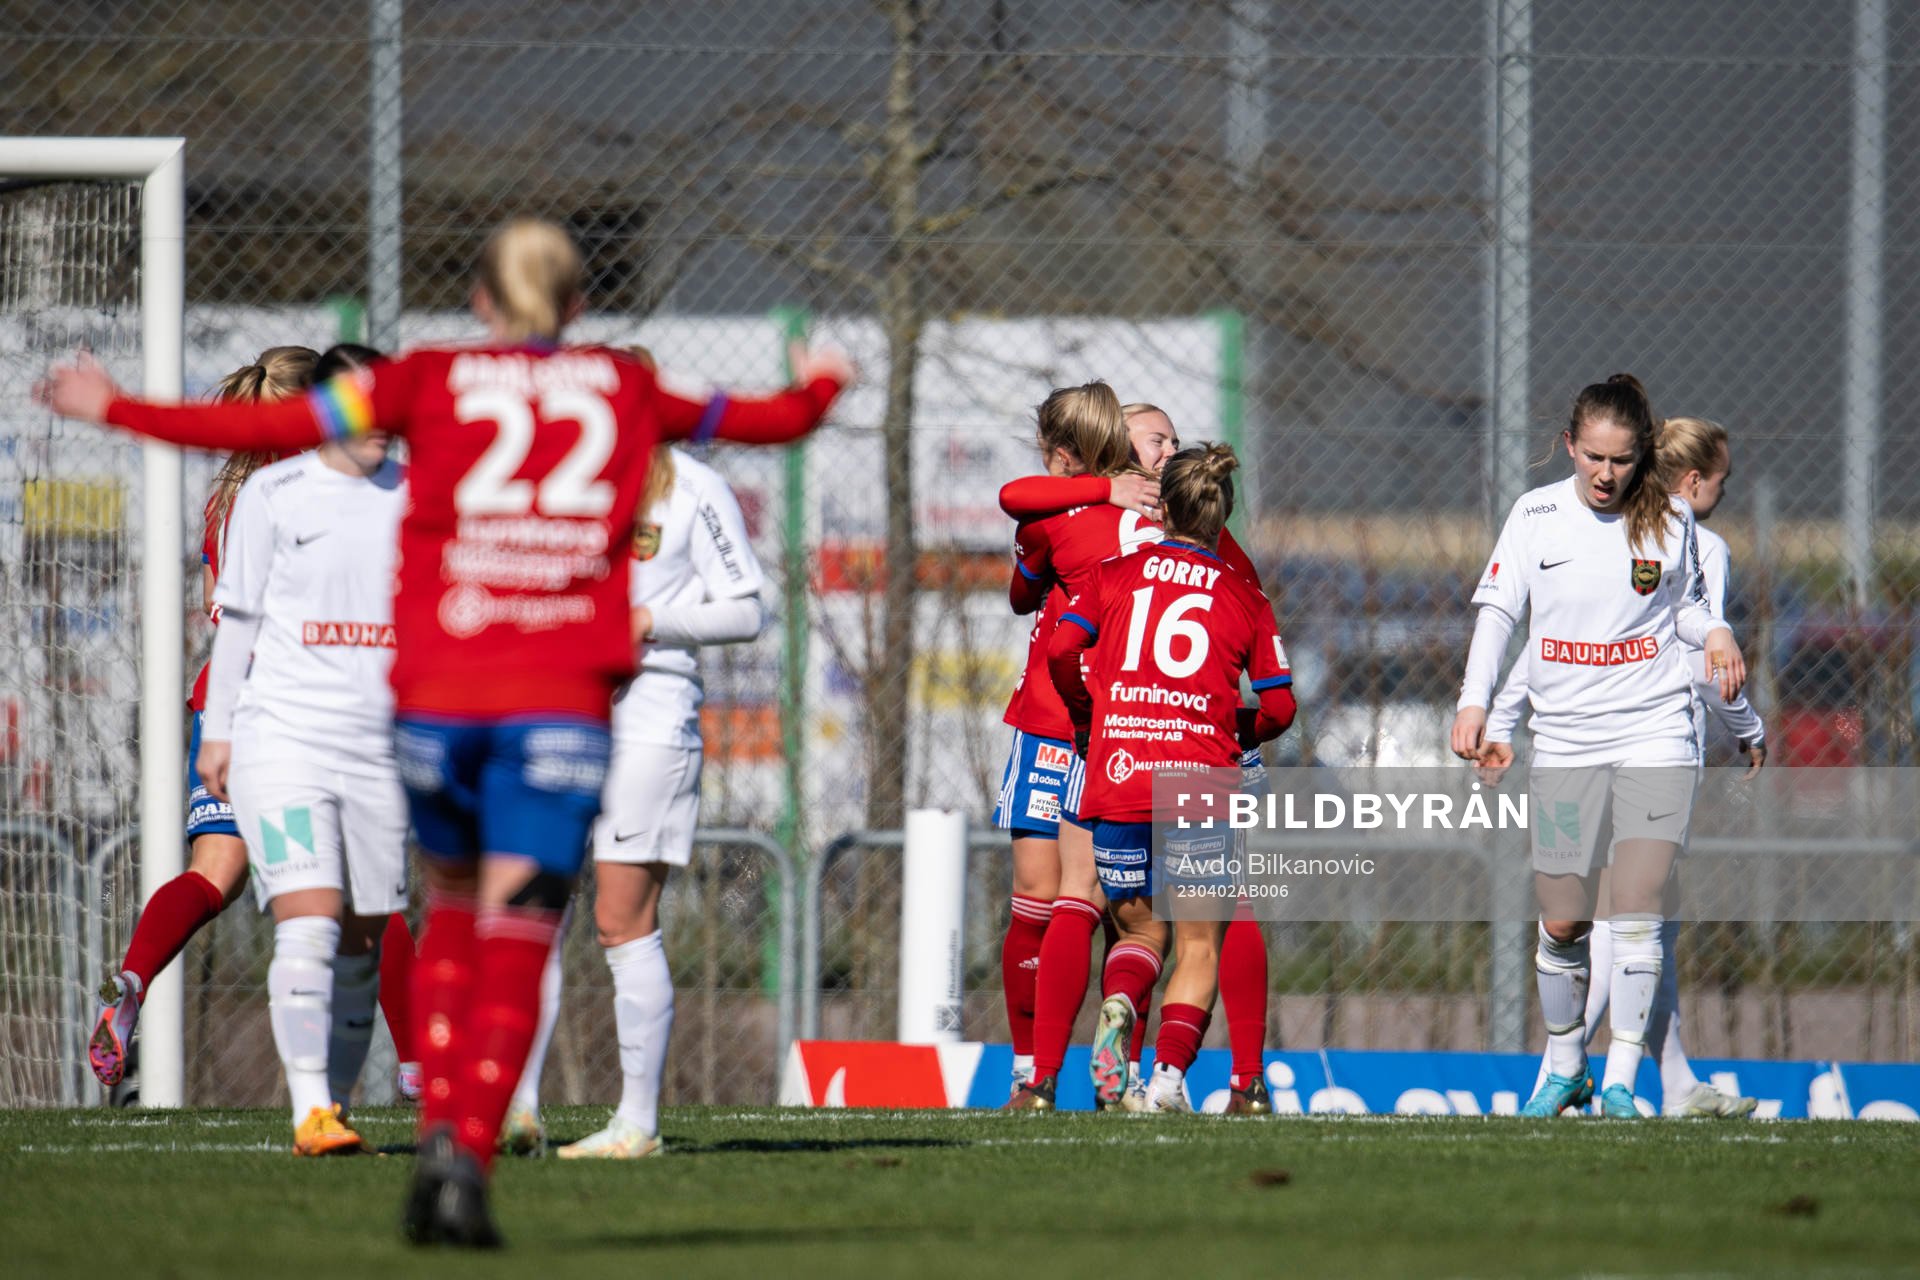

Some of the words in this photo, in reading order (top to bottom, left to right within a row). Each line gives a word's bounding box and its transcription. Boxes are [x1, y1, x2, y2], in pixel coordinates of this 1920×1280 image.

[456, 392, 617, 515] 22
[1525, 503, 1557, 517] Heba
[1143, 556, 1221, 590] GORRY
[1121, 586, 1214, 679] 16
[1543, 639, 1657, 663] BAUHAUS
[1104, 714, 1215, 736] Motorcentrum
[1108, 729, 1163, 741] Markaryd
[1164, 731, 1184, 741] AB
[1134, 760, 1211, 775] MUSIKHUSET
